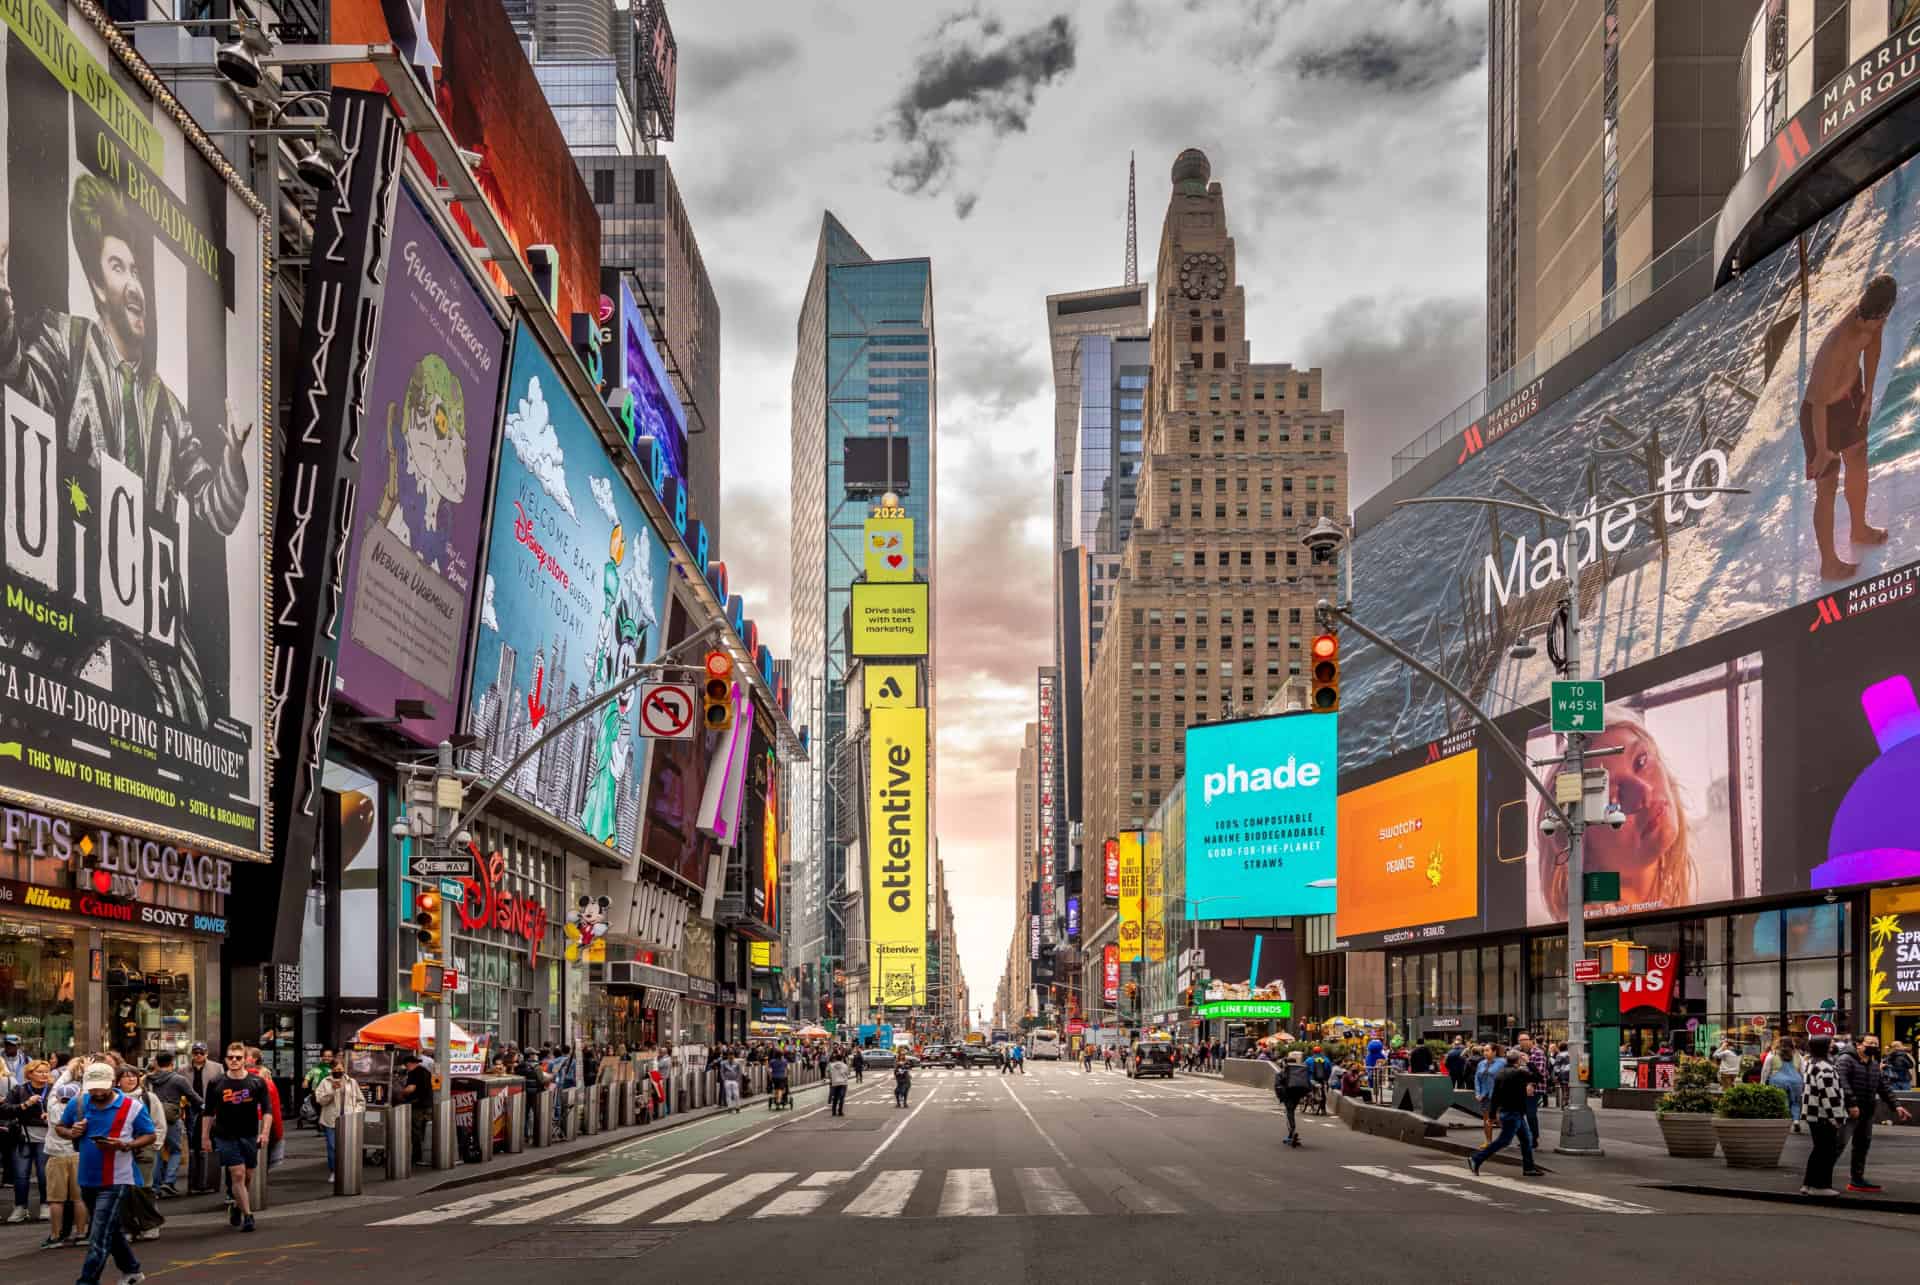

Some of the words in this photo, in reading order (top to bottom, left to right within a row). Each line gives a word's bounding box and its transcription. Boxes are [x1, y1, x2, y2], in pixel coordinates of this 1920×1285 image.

[0, 0, 79, 83] AISING
[86, 63, 150, 164] SPIRITS
[97, 131, 120, 184] ON
[127, 160, 219, 281] BROADWAY!
[1488, 377, 1544, 424] MARRIOTT
[1488, 399, 1537, 440] MARQUIS
[873, 507, 905, 519] 2022
[519, 478, 569, 556] WELCOME
[573, 547, 597, 589] BACK
[1482, 496, 1638, 616] Made
[1657, 449, 1728, 525] to
[517, 555, 547, 600] VISIT
[546, 556, 570, 592] store
[1848, 583, 1914, 614] MARQUIS
[865, 625, 914, 634] marketing
[868, 616, 888, 624] with
[892, 616, 912, 624] text
[1569, 686, 1584, 697] TO
[24, 672, 158, 750] JAW-DROPPING
[1558, 699, 1568, 711] W
[1568, 700, 1584, 711] 45
[1586, 700, 1597, 711] St
[1442, 728, 1477, 746] MARRIOTT
[1442, 740, 1473, 754] MARQUIS
[28, 748, 51, 771] THIS
[54, 756, 76, 777] WAY
[79, 764, 93, 783] TO
[95, 769, 112, 789] THE
[114, 775, 176, 808] NETHERWORLD
[189, 799, 208, 818] 50TH
[210, 806, 216, 819] &
[217, 807, 256, 832] BROADWAY
[1204, 753, 1321, 807] phade
[880, 744, 911, 913] attentive
[1215, 817, 1239, 830] 100%
[1244, 812, 1313, 828] COMPOSTABLE
[1379, 821, 1415, 840] swatch
[1204, 832, 1240, 844] MARINE
[1244, 826, 1325, 842] BIODEGRADABLE
[100, 830, 232, 895] LUGGAGE
[418, 862, 440, 871] ONE
[446, 862, 465, 872] WAY
[1244, 858, 1283, 870] STRAWS
[1386, 856, 1415, 873] PEANUTS
[111, 874, 140, 900] NY
[24, 886, 71, 911] Nikon
[79, 896, 132, 921] Canon
[141, 906, 188, 927] SONY
[194, 914, 227, 933] BOWER
[1384, 932, 1409, 943] swatch
[1422, 925, 1446, 938] PEANUTS
[876, 945, 919, 954] attentive
[1896, 970, 1915, 979] BUY
[1221, 1005, 1241, 1013] LINE
[1244, 1005, 1282, 1014] FRIENDS
